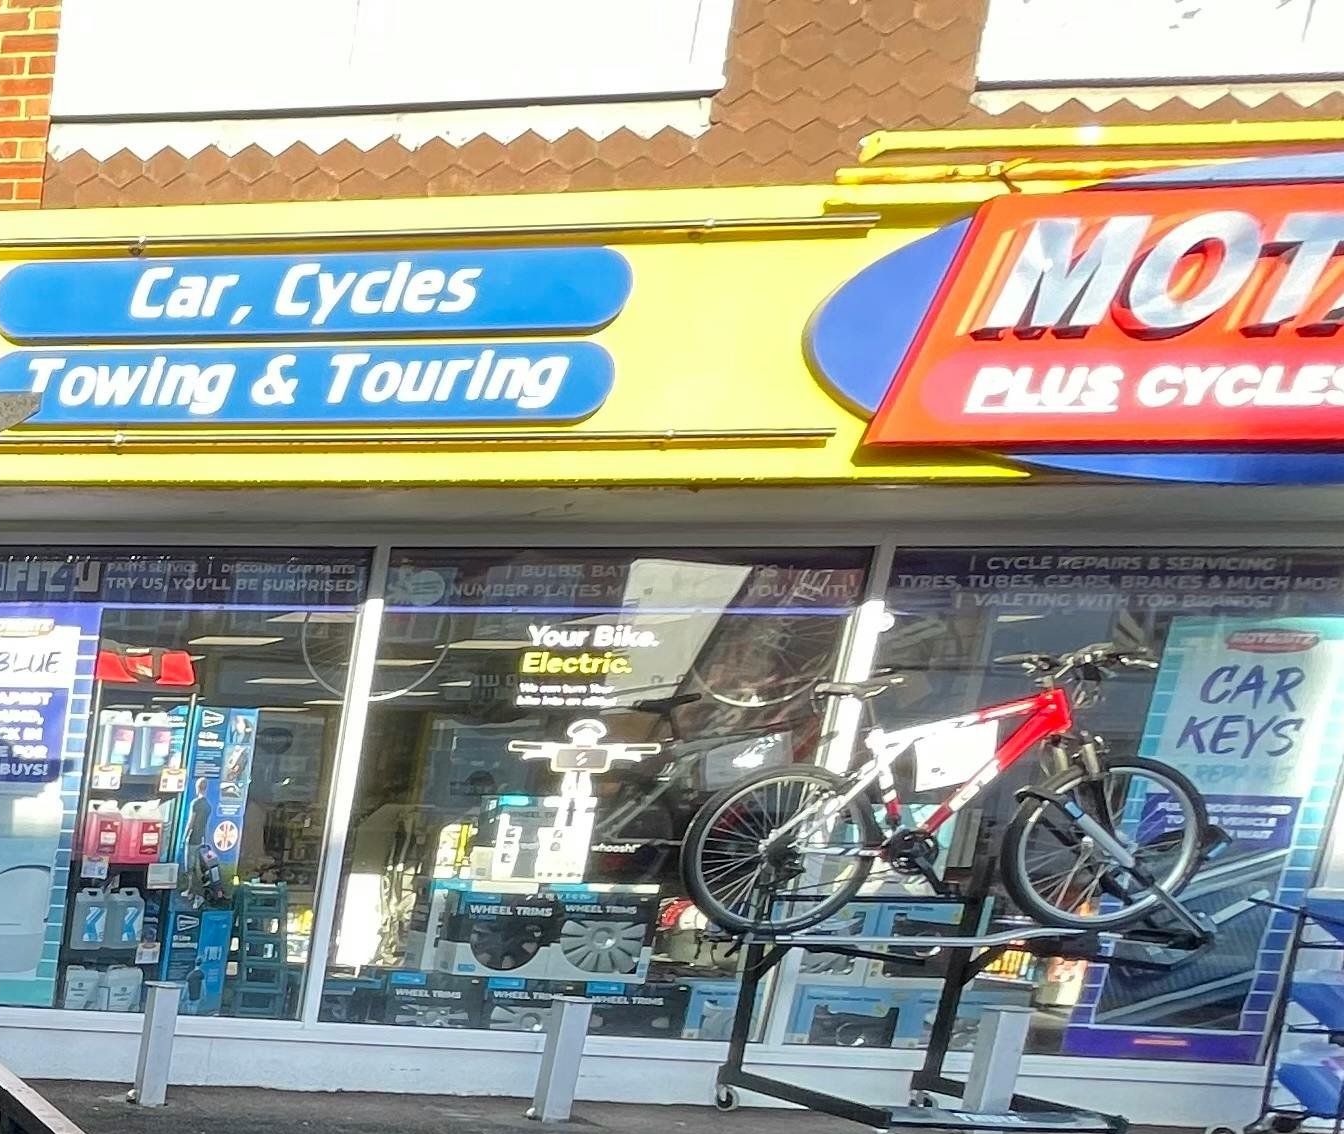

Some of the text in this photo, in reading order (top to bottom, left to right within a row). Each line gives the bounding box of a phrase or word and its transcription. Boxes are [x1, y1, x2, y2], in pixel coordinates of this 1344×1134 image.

[984, 211, 1344, 325] MOT
[130, 260, 483, 327] Car, Cycles
[28, 353, 569, 414] Towing & Touring
[964, 366, 1124, 412] PLUS
[221, 564, 283, 574] DISCOUNT
[986, 555, 1278, 572] CYCLE REPAIRS & SERVICING
[107, 577, 141, 590] TRY
[143, 577, 168, 593] US,
[236, 578, 258, 591] BE
[449, 584, 528, 598] NUMBER
[532, 584, 602, 598] PLATES
[897, 574, 961, 592] TYRES,
[966, 574, 1038, 592] TUBES,
[1120, 575, 1204, 589] BRAKES
[1226, 575, 1289, 591] MUCH
[973, 592, 1070, 608] VALETING
[1077, 593, 1129, 608] WITH
[1136, 594, 1177, 608] TOP
[528, 624, 661, 648] Your Bike.
[521, 651, 633, 675] Electric.
[1200, 664, 1306, 712] CAR
[23, 727, 44, 741] IN
[1175, 714, 1305, 760] KEYS
[12, 744, 49, 759] FOR
[469, 904, 553, 917] WHEEL TRIMS
[564, 904, 638, 916] WHEEL TRIMS
[395, 988, 463, 1000] WHEEL TRIMS
[493, 990, 530, 1000] WHEEL
[632, 996, 664, 1006] TRIMS
